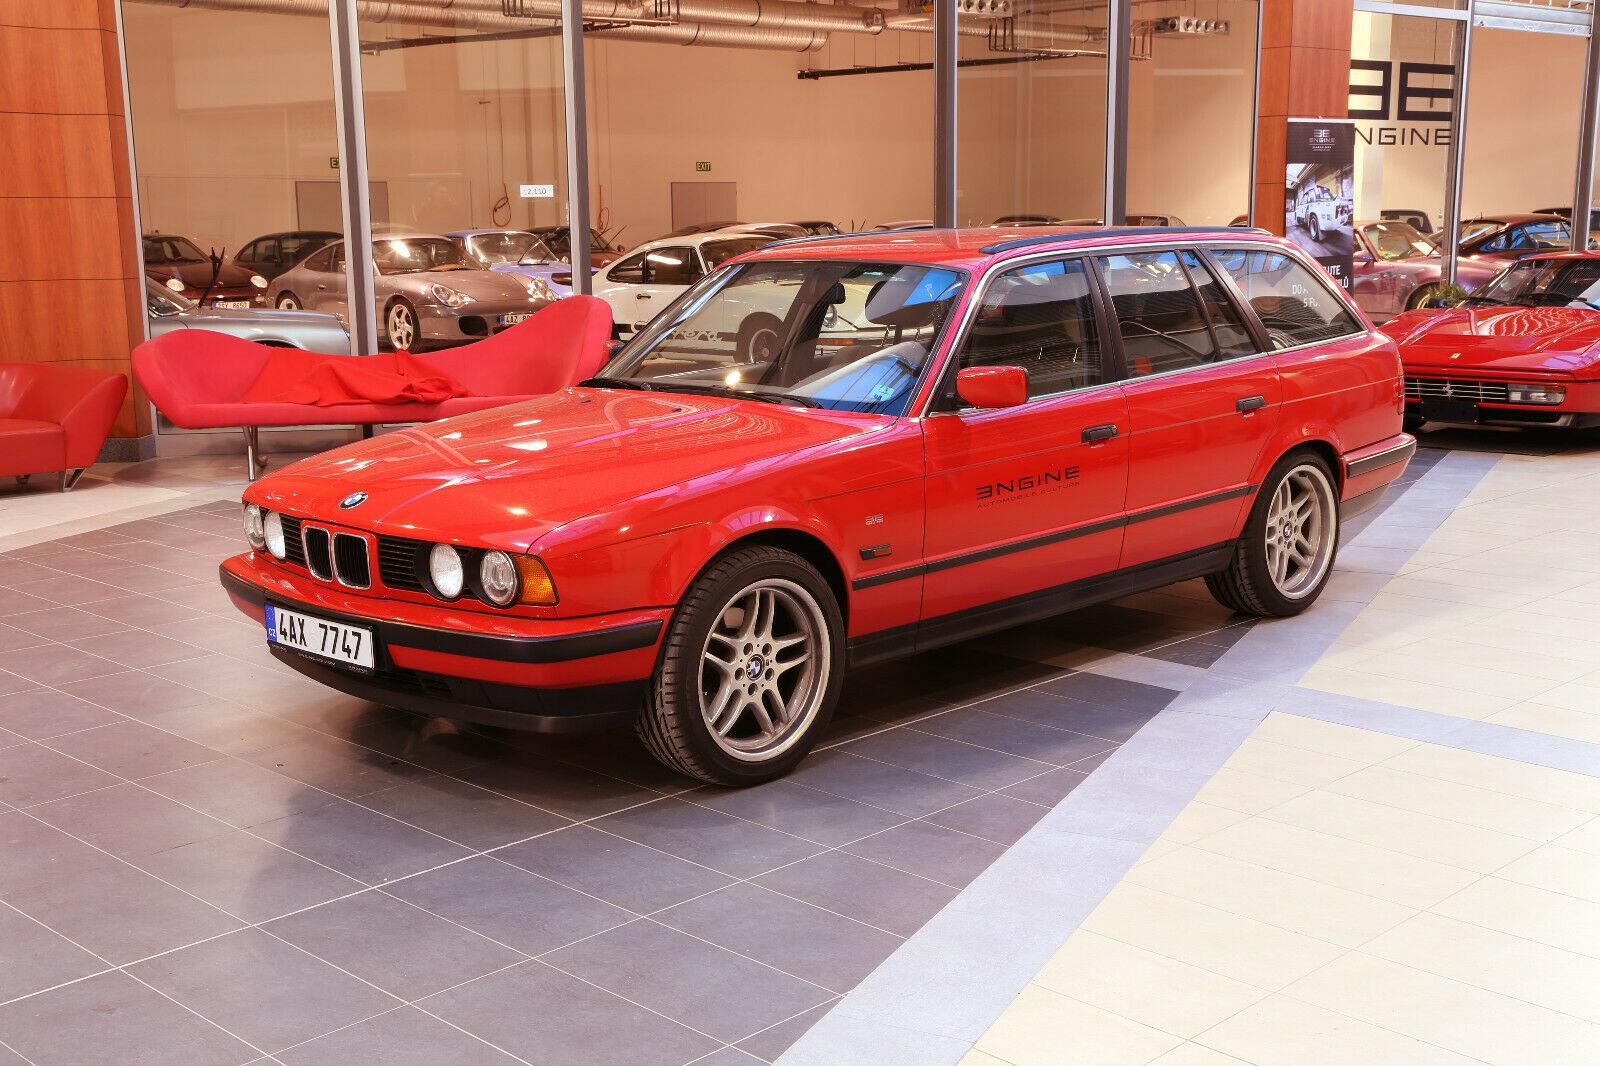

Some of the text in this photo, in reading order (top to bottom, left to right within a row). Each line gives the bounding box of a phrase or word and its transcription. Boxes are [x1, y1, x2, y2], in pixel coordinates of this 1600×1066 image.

[1354, 127, 1452, 145] NGINE
[697, 162, 710, 171] EXIT
[280, 613, 308, 647] 4AX
[319, 623, 362, 660] 7747
